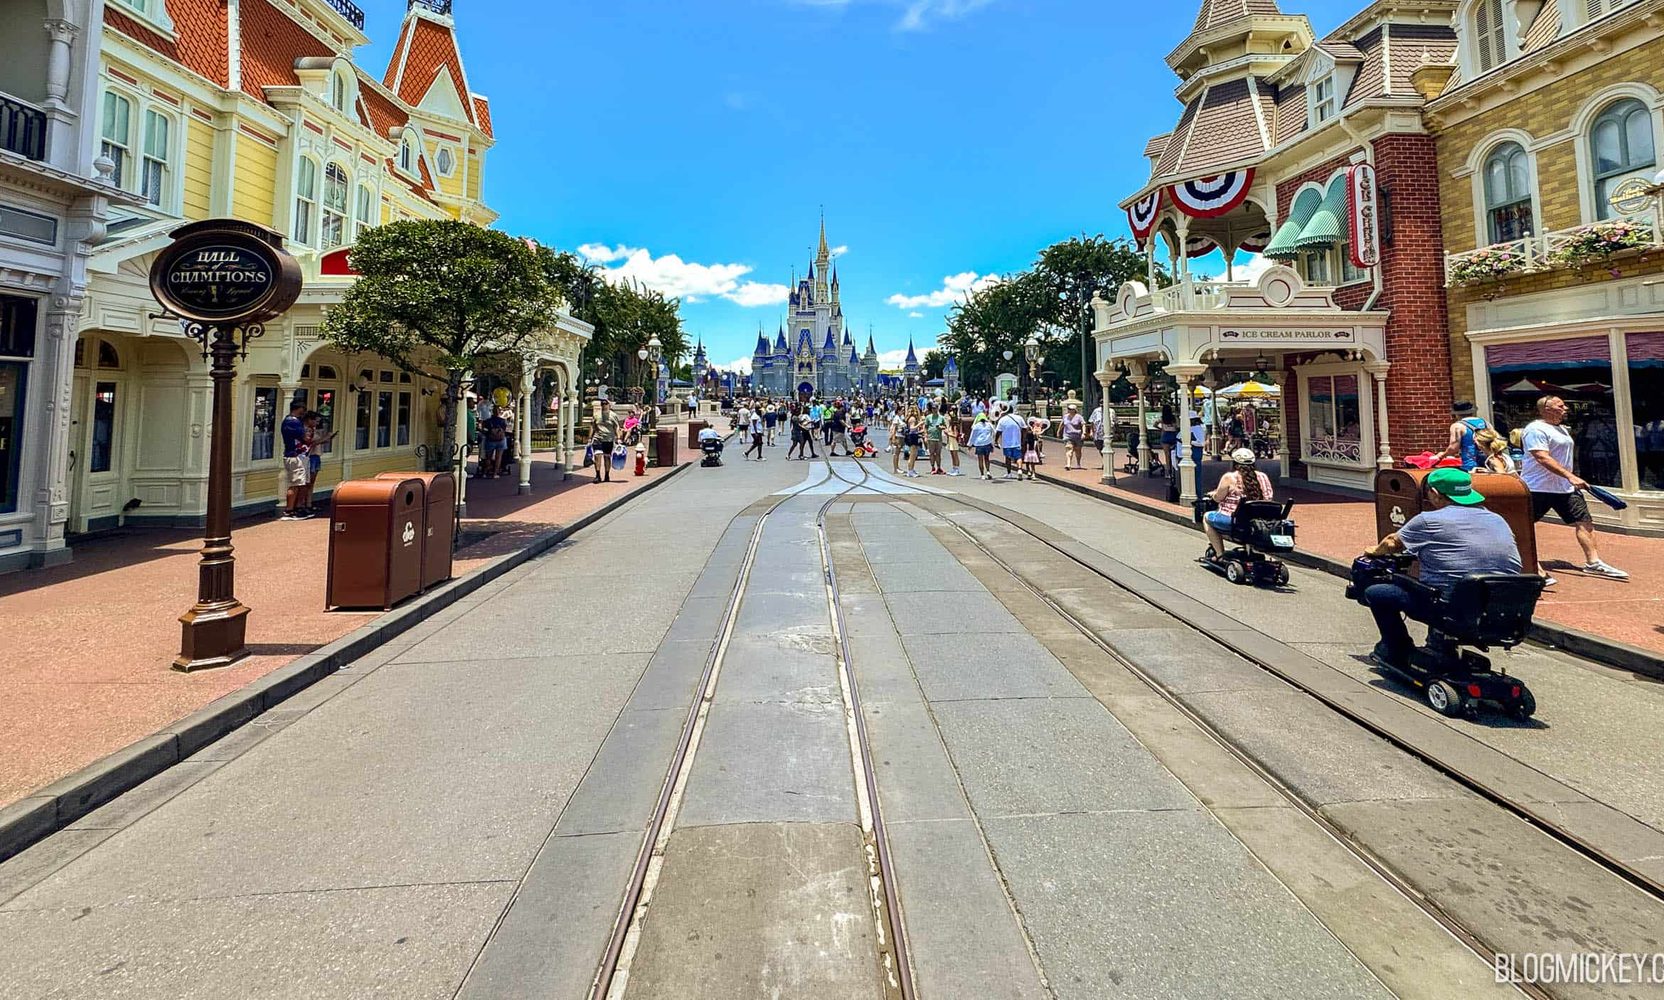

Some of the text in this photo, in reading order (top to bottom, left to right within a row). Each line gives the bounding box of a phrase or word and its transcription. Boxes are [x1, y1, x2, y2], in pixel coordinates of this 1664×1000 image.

[1360, 167, 1372, 202] ICE
[198, 251, 240, 262] HALL
[211, 262, 223, 270] of
[171, 271, 267, 283] CHAMPIONS
[1242, 330, 1258, 338] ICE
[1260, 330, 1292, 339] CREAM
[1295, 330, 1331, 339] PARLOR
